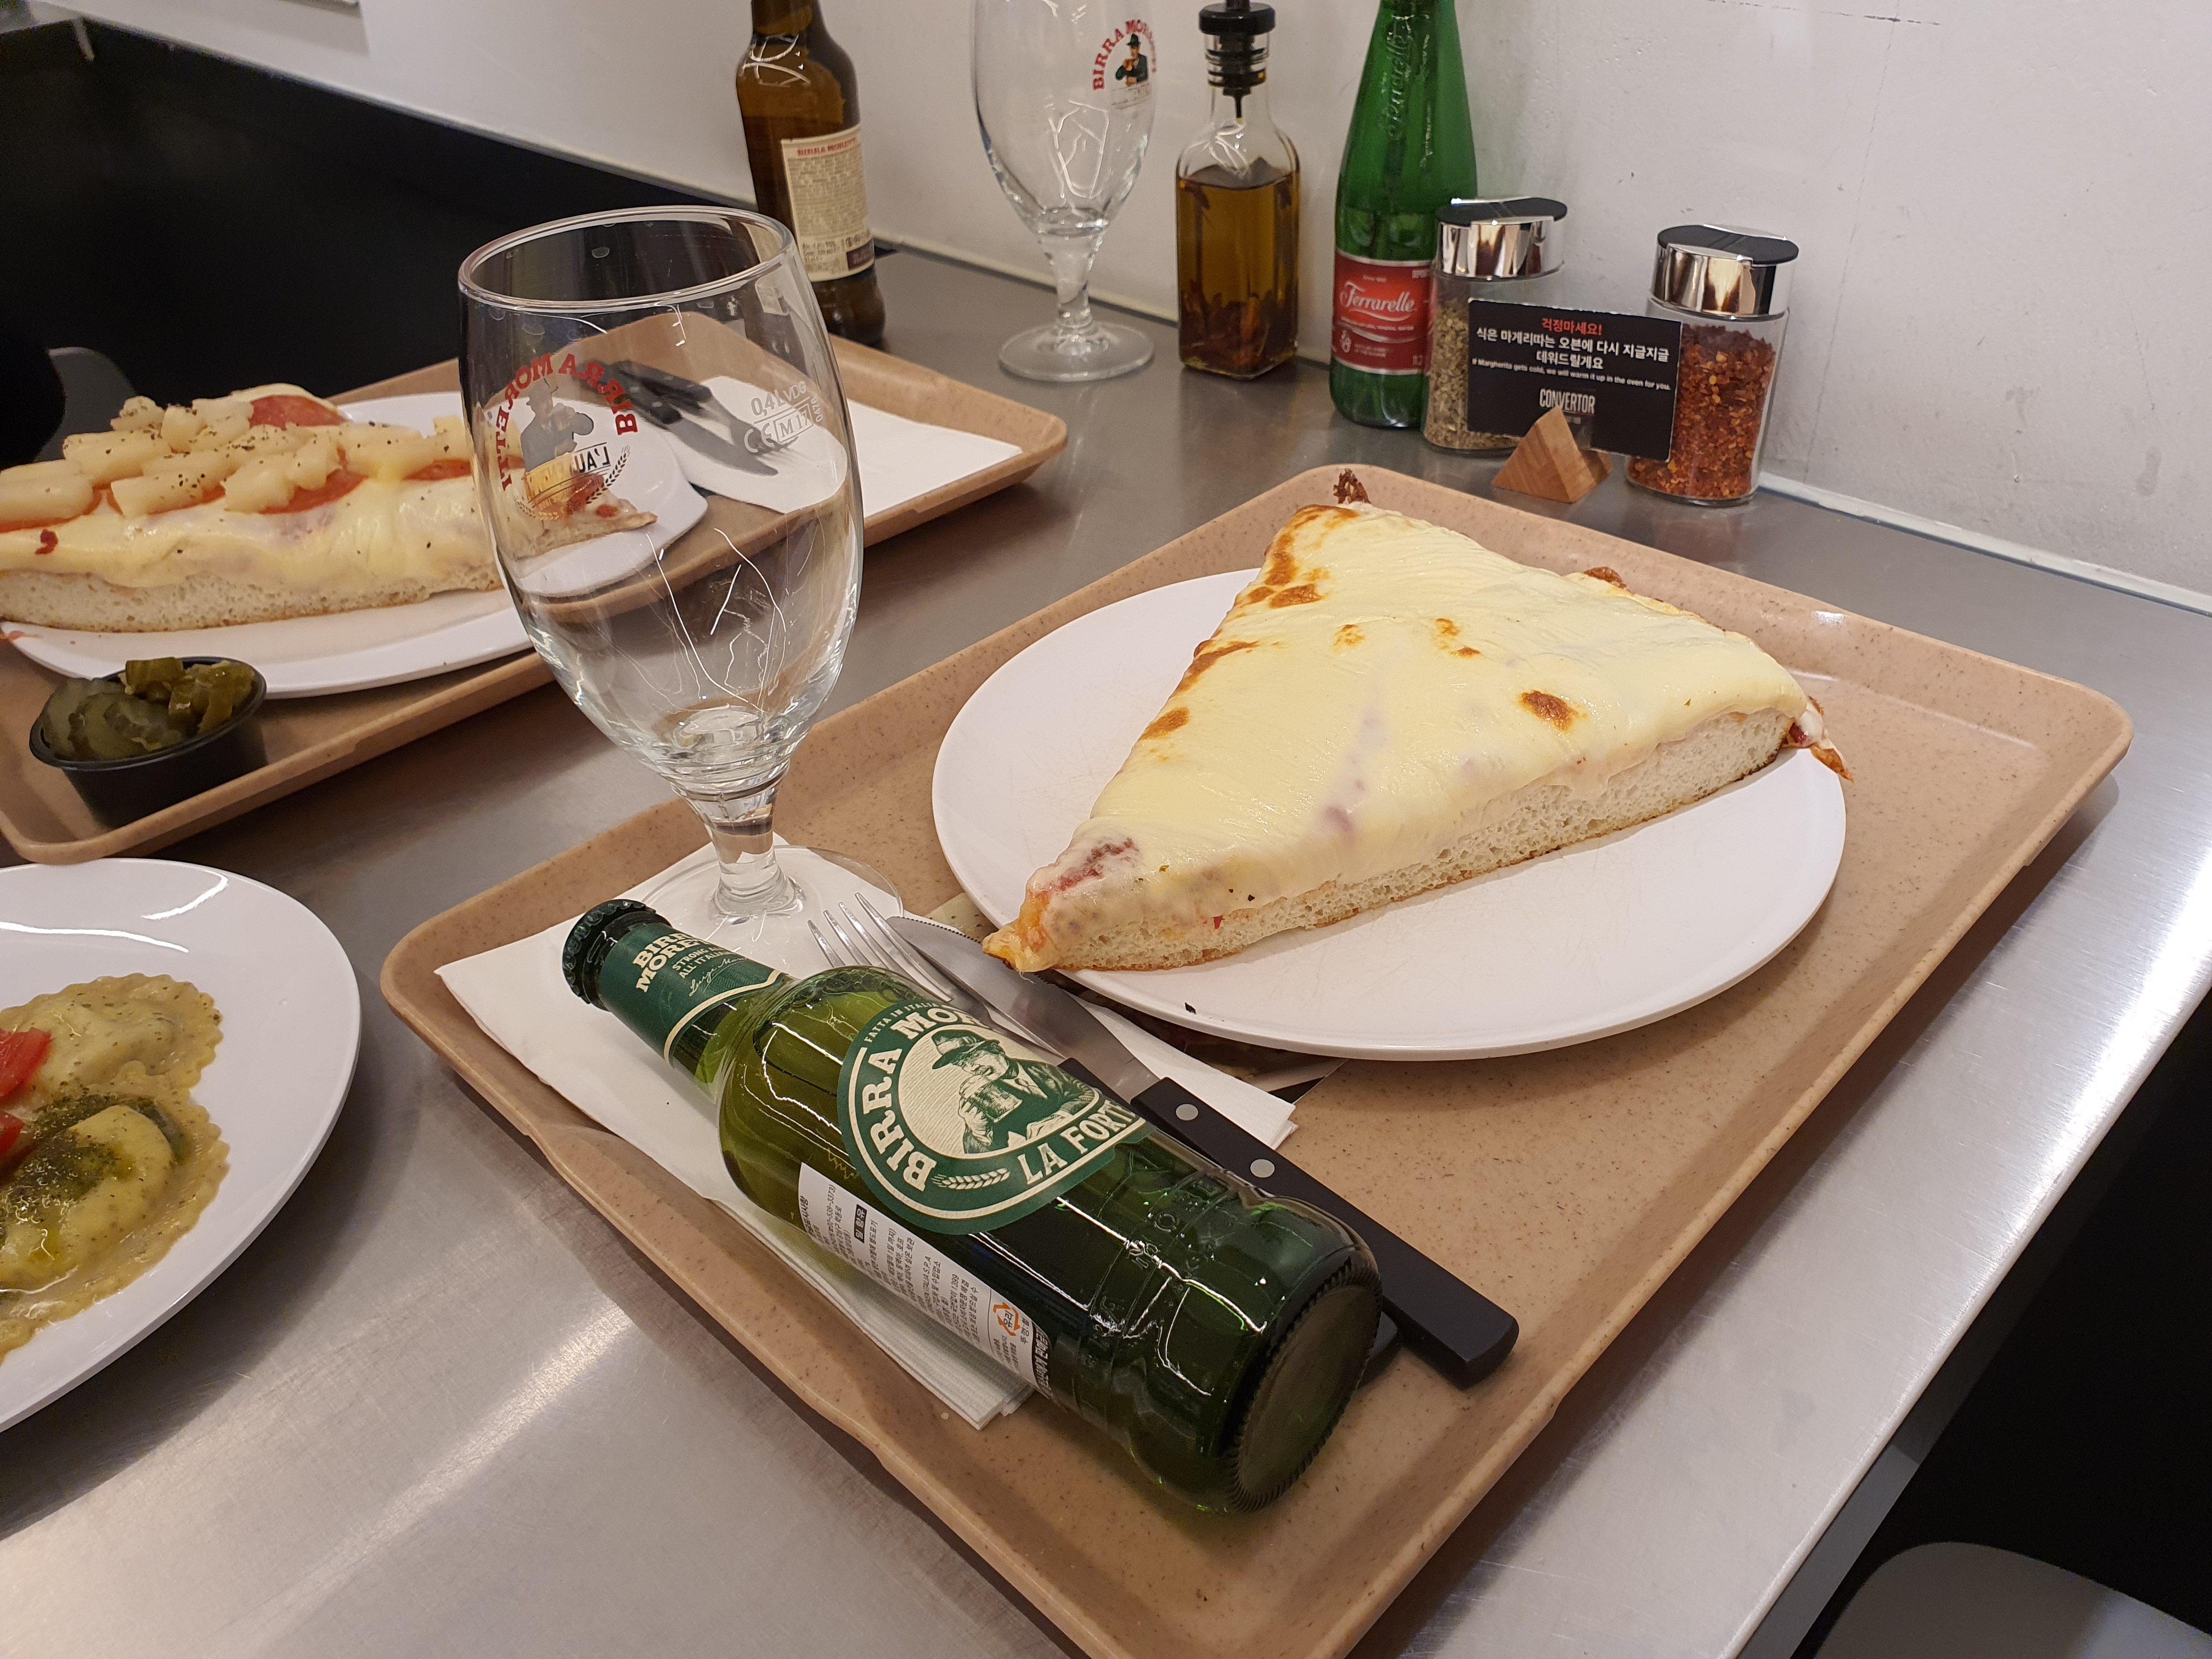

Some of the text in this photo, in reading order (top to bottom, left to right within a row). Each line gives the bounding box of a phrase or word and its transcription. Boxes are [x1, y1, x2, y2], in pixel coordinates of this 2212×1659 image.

[1093, 29, 1125, 91] BIRRA
[1542, 318, 1602, 335] 걱정마세요!
[1476, 327, 1498, 342] 식은
[1559, 336, 1593, 353] 오븐에
[1596, 340, 1620, 356] 다시
[1623, 343, 1669, 362] 지글지글
[1536, 350, 1604, 369] 데워드릴게요
[1614, 376, 1626, 384] the
[1627, 379, 1644, 387] oven
[1645, 380, 1655, 388] for
[1539, 388, 1596, 414] CONVERTOR
[672, 947, 708, 970] STRONG
[864, 1002, 939, 1043] FATTA IN ITALIA
[862, 1048, 937, 1192] BIRRA
[1017, 1142, 1068, 1185] LA
[855, 1209, 865, 1239] 밀 함유
[906, 1237, 915, 1251] 보관
[932, 1261, 941, 1284] 수입업소
[951, 1273, 960, 1290] 1399
[1003, 1310, 1014, 1328] 유리
